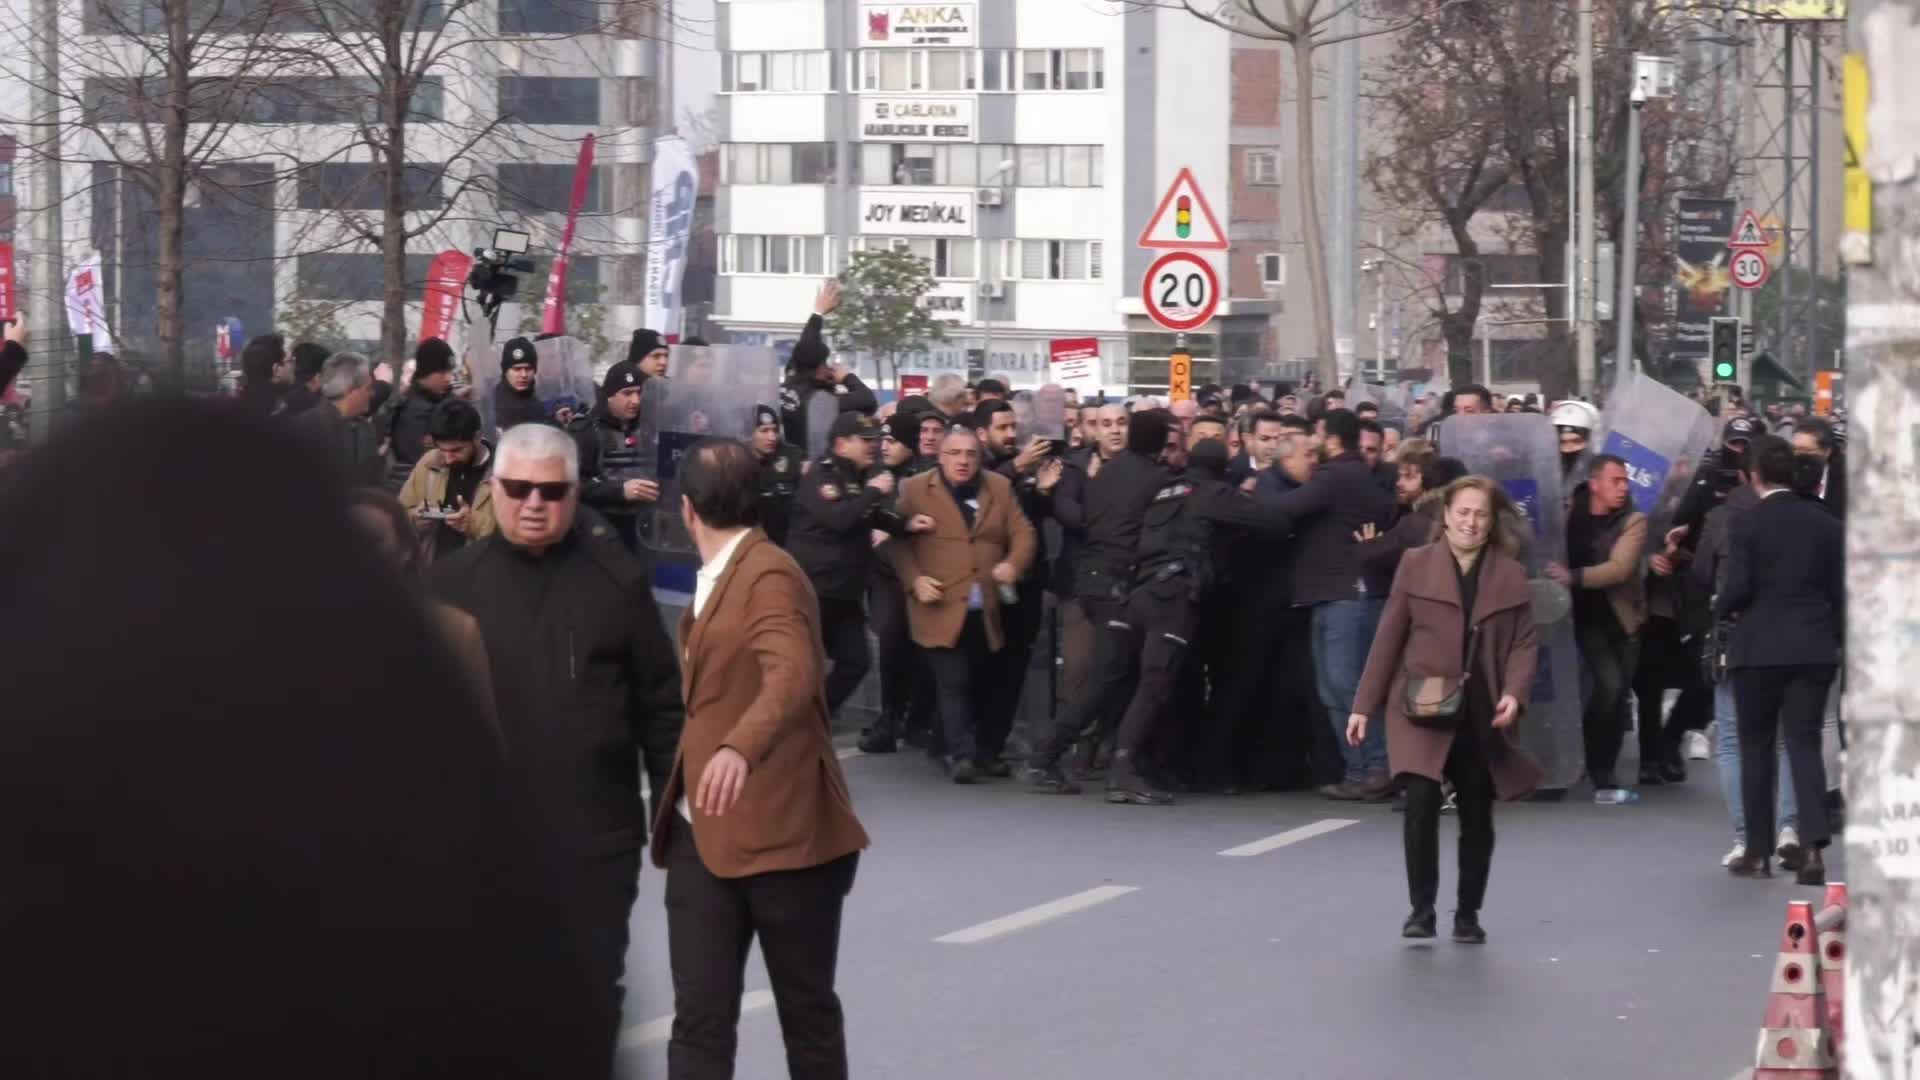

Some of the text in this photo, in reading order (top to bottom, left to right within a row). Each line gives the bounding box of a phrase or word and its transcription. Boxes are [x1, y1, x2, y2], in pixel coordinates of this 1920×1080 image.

[898, 7, 964, 24] ANKA
[865, 201, 966, 223] JOY MEDİKAL
[1737, 259, 1761, 277] 30
[1160, 273, 1204, 307] 20
